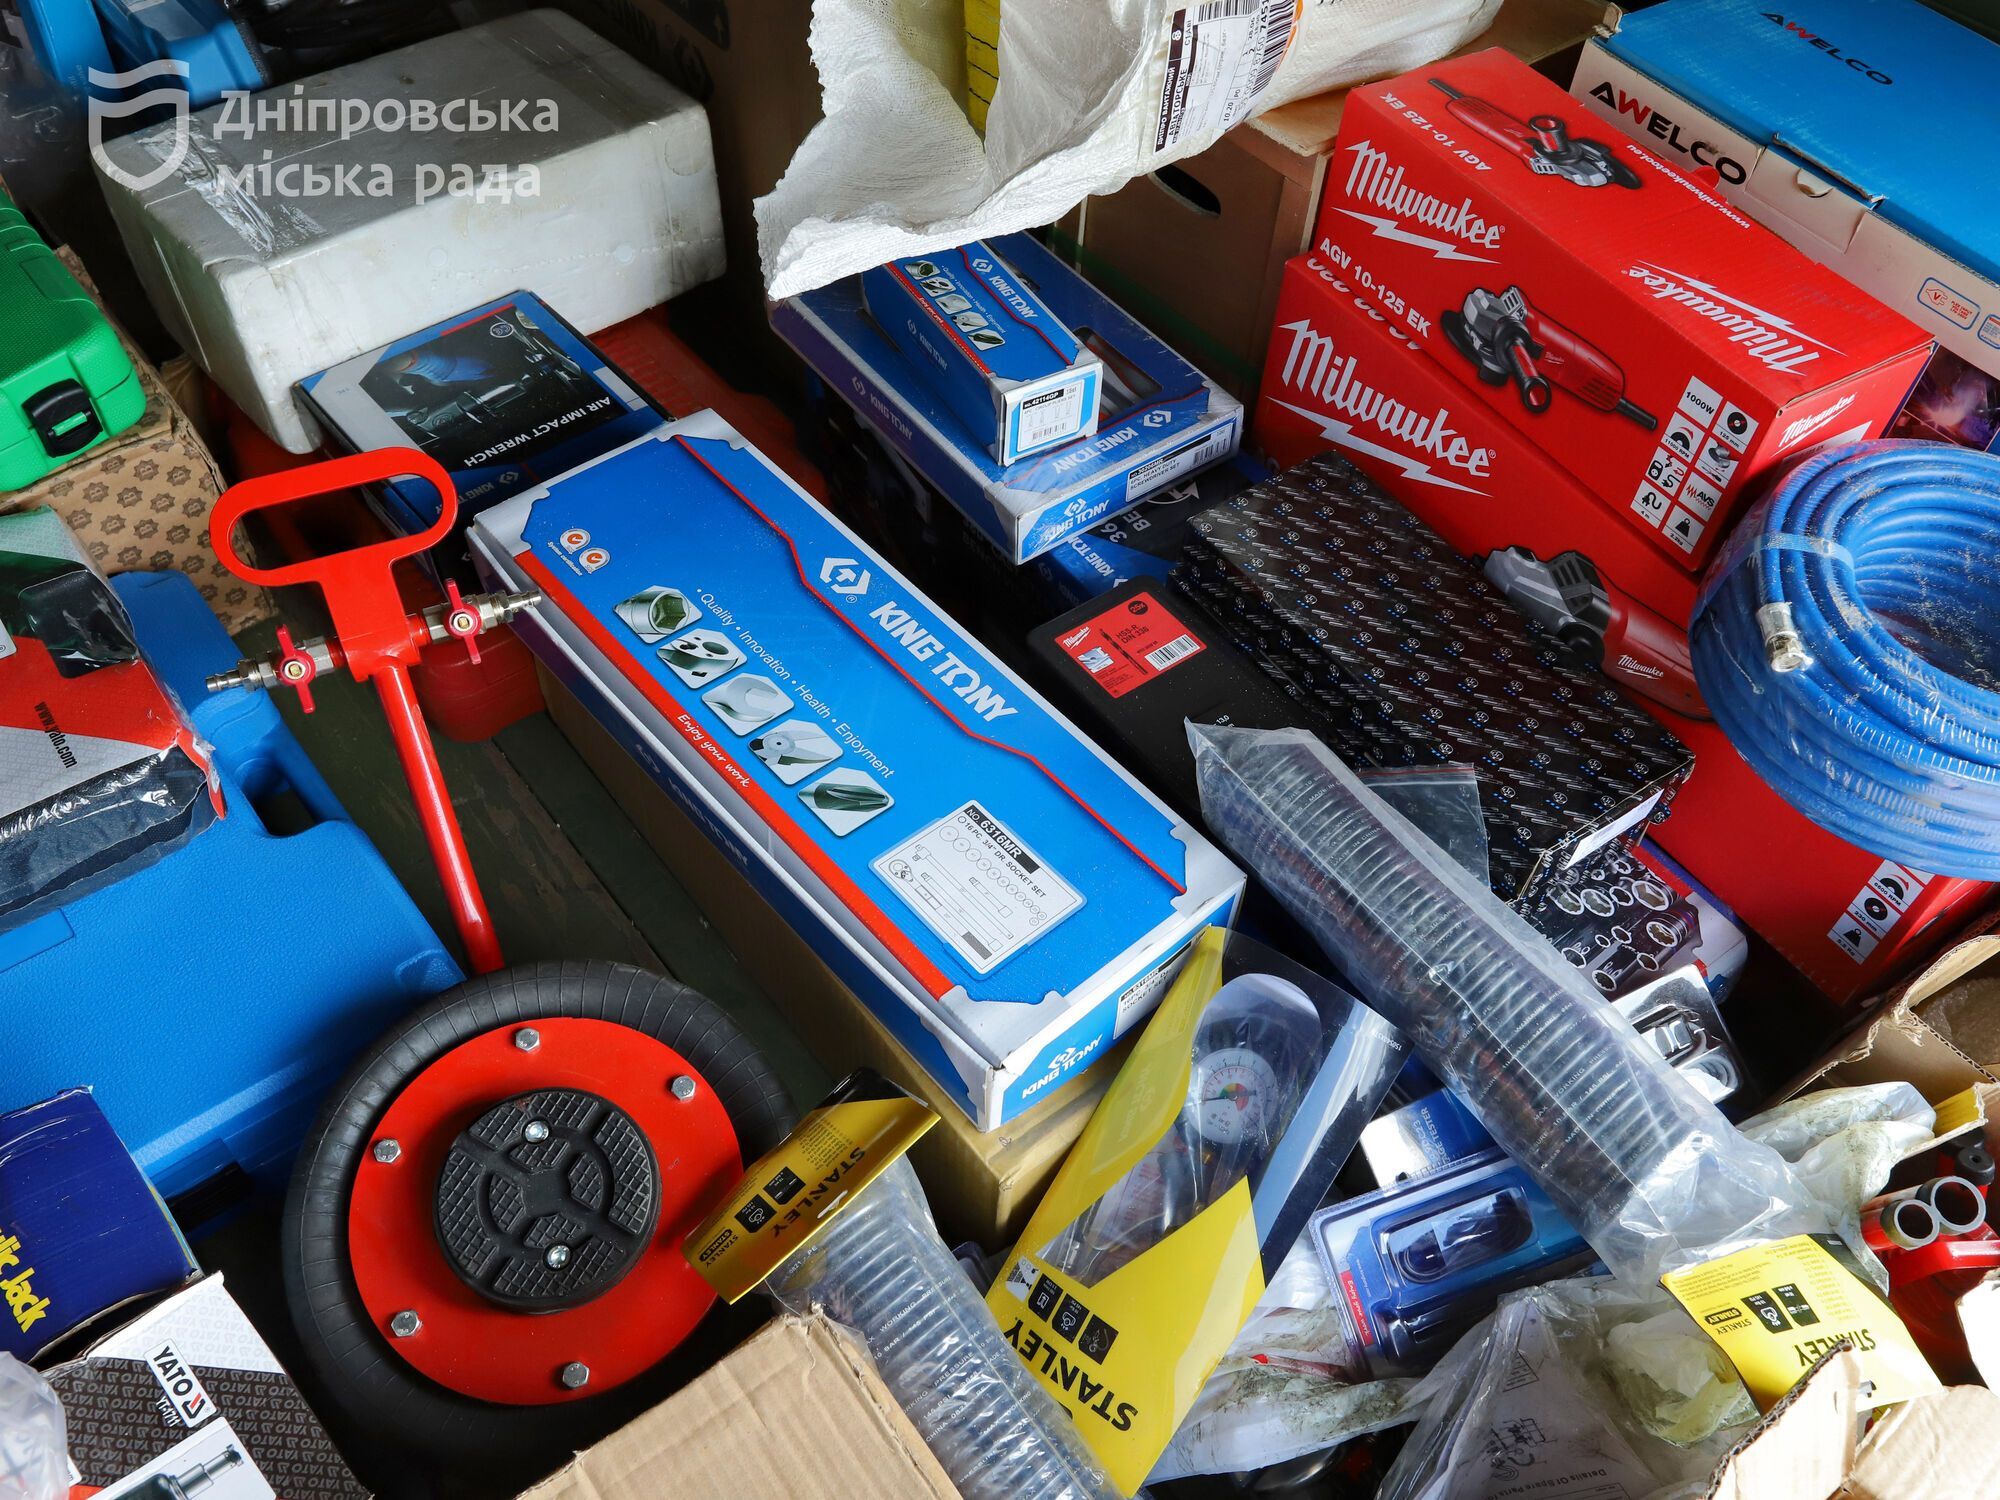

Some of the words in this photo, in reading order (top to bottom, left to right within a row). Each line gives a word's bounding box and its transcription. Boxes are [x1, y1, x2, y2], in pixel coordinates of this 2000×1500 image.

[1761, 12, 1893, 86] AWELCO
[1168, 68, 1187, 136] АВІАТОРСЬКЕ
[1379, 91, 1407, 111] EK
[1403, 108, 1457, 145] 10-125
[1588, 81, 1747, 186] AWELCO
[1456, 141, 1492, 171] AGV
[1345, 139, 1501, 249] Milwaukee
[1626, 143, 1751, 230] www.milwaukeetool.eu
[988, 275, 1012, 297] KING
[1008, 295, 1039, 319] TONY
[1320, 238, 1351, 270] AGV
[1354, 265, 1406, 316] 10-125
[1406, 307, 1431, 338] EK
[1628, 264, 1820, 377] Milwaukee
[588, 396, 612, 412] AIR
[1277, 319, 1491, 478] Milwaukee
[1685, 391, 1716, 415] 1000W
[533, 406, 588, 438] IMPACT
[1778, 391, 1857, 447] Milwaukee
[463, 433, 532, 467] WRENCH
[1099, 426, 1140, 453] KING
[1052, 446, 1100, 475] TONY
[466, 482, 495, 503] KING
[1696, 490, 1716, 508] AVS
[1077, 500, 1111, 524] TONY
[1086, 551, 1115, 577] KING
[869, 600, 945, 662] KING
[931, 652, 1019, 722] TONY
[1618, 654, 1664, 677] Milwaukee
[700, 592, 736, 627] Quality
[739, 629, 790, 681] Innovation
[794, 683, 831, 720] Health
[834, 722, 895, 779] Enjoyment
[34, 701, 78, 769] www.yato.com
[677, 713, 704, 743] Enjoy
[700, 740, 727, 765] your
[725, 763, 750, 788] work
[966, 808, 981, 823] NO.
[980, 819, 1022, 858] 6316MR
[963, 823, 974, 833] 16
[1005, 861, 1034, 888] SOCKET
[1030, 885, 1046, 899] SET
[1887, 893, 1903, 907] RPM
[1022, 1067, 1061, 1100] KING
[1063, 1034, 1103, 1073] TONY
[1420, 1106, 1441, 1149] TESTER
[770, 1146, 866, 1238] STANLEY
[701, 1230, 731, 1260] STANLEY
[706, 1234, 739, 1269] STANLEY
[0, 1266, 51, 1334] Jack
[879, 1300, 917, 1332] WORKING
[1708, 1308, 1740, 1325] STANLEY
[883, 1337, 901, 1352] BAR
[1716, 1318, 1753, 1336] STANLEY
[153, 1345, 194, 1397] YATO
[933, 1351, 975, 1388] PRESSURE
[1003, 1318, 1139, 1432] STANLEY
[155, 1395, 180, 1428] YT-1711
[925, 1421, 950, 1444] CHINA
[1558, 1475, 1570, 1484] Of
[1571, 1466, 1608, 1482] Details
